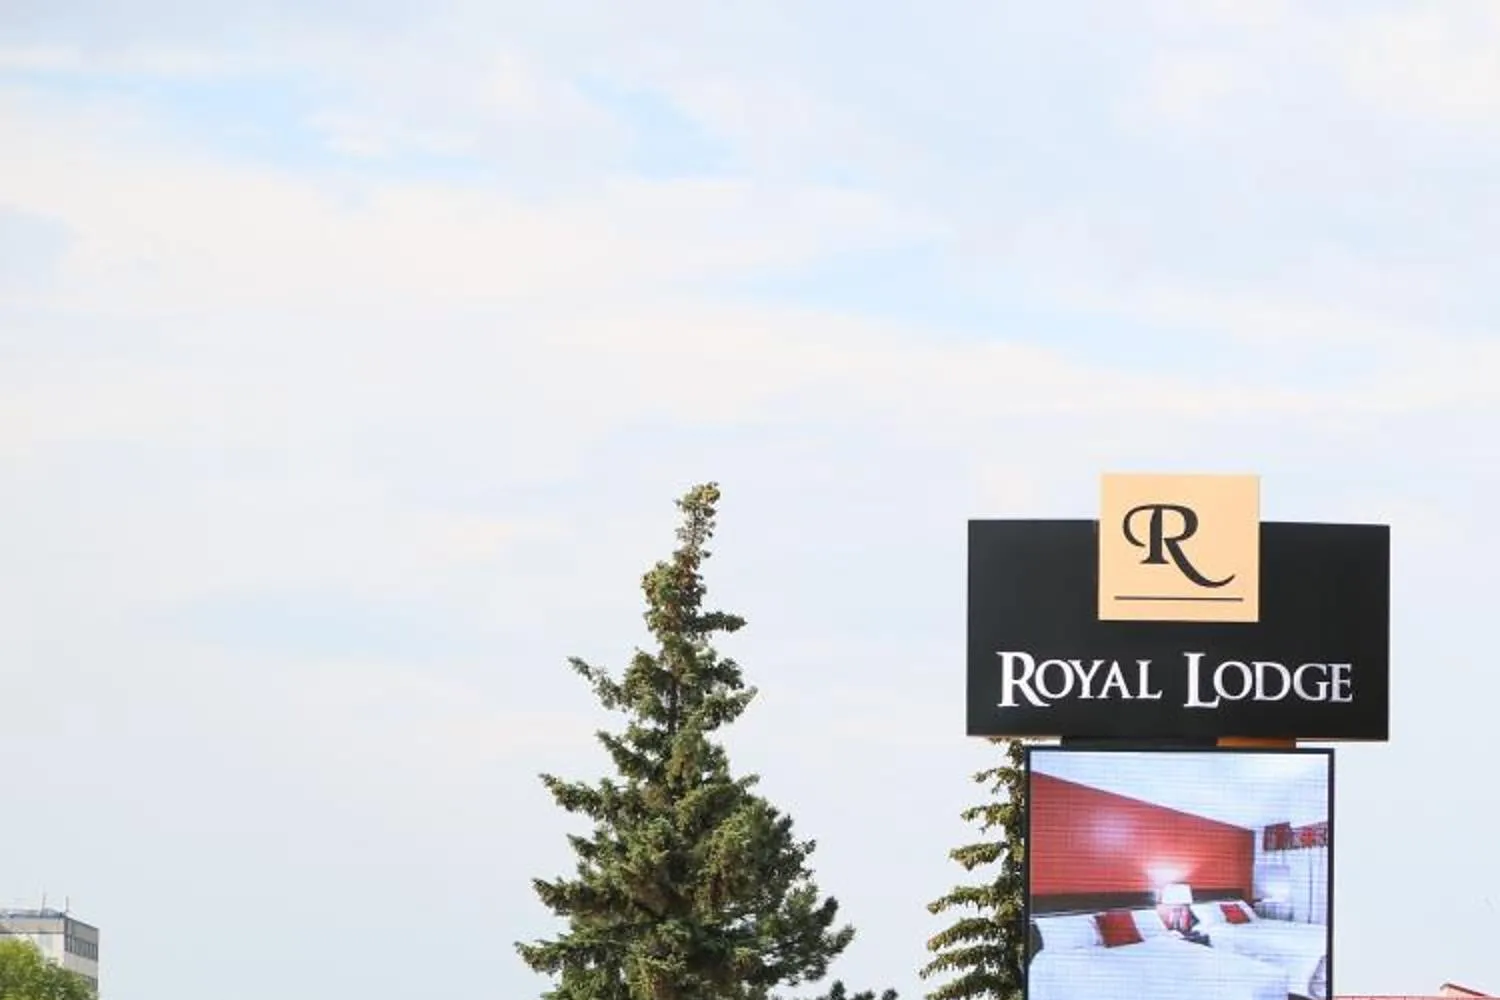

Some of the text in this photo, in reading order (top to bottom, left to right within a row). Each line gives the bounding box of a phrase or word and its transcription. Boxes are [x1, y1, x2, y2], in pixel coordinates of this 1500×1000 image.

[1122, 503, 1236, 589] R
[996, 651, 1354, 709] ROYAL LODGE
